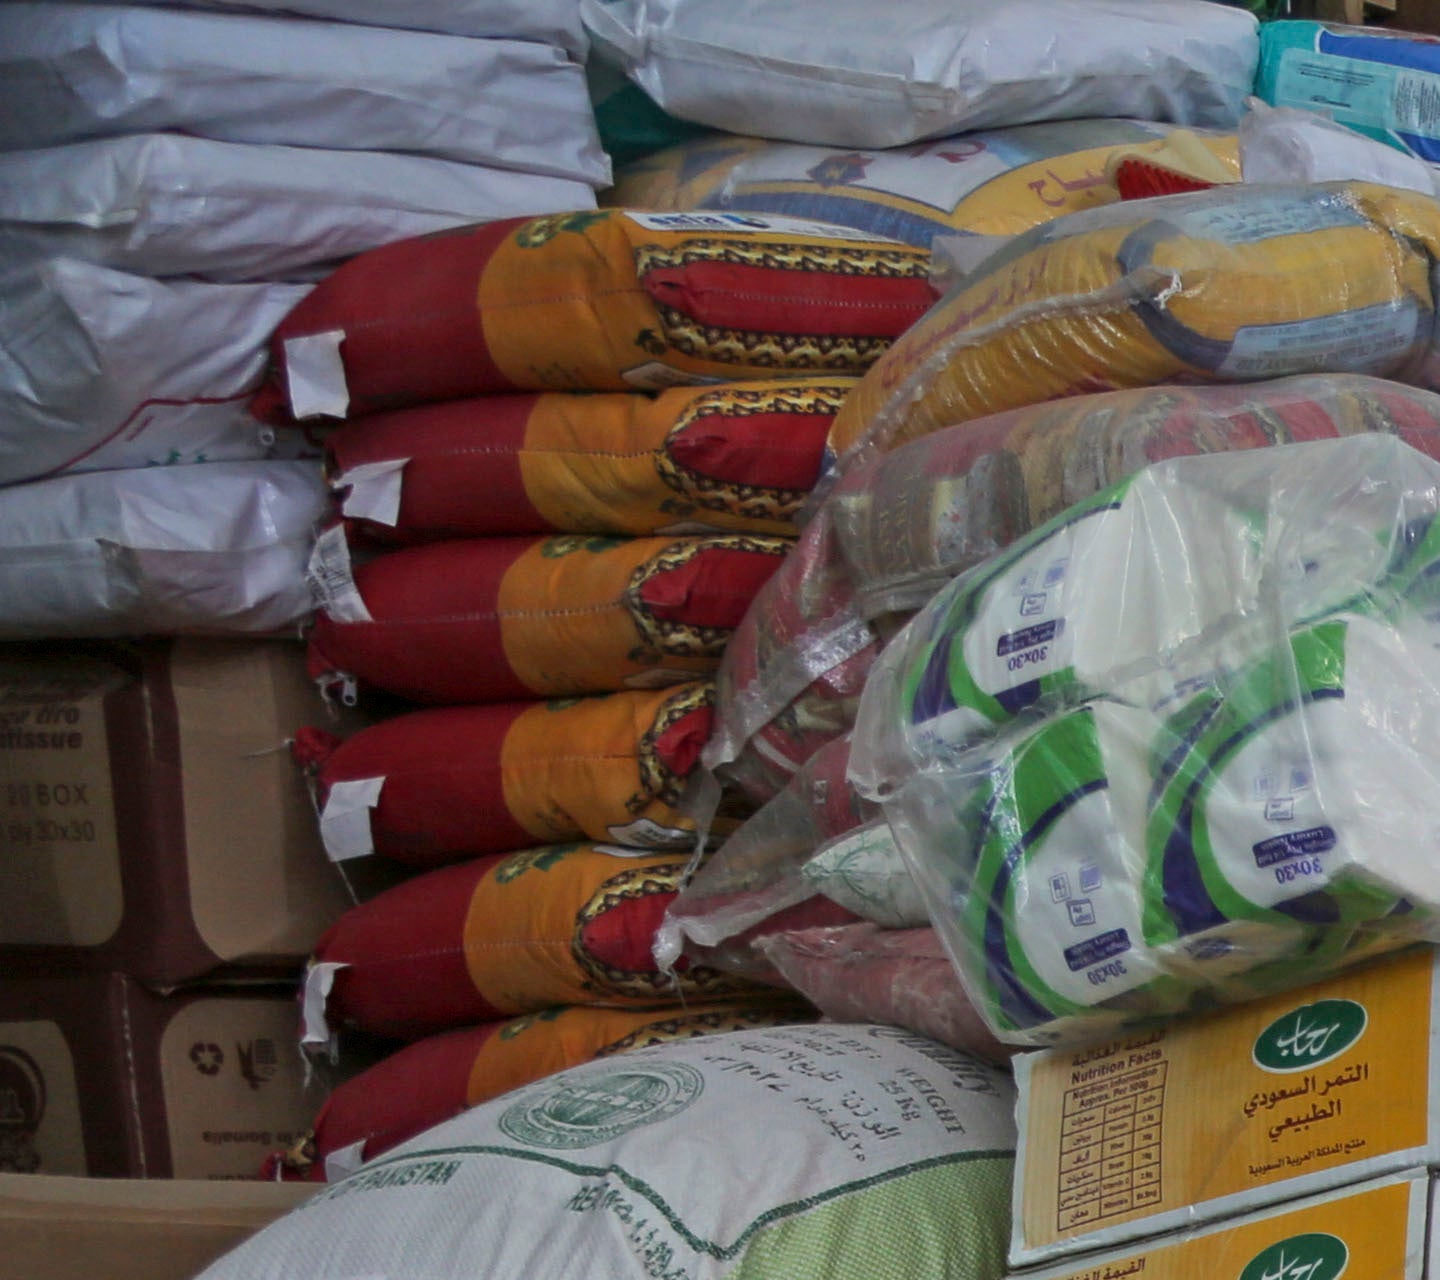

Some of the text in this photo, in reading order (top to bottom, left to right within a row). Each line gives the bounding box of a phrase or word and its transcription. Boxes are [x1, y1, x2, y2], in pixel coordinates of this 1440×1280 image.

[1274, 858, 1323, 884] 30x30
[1087, 959, 1128, 986] 30x30
[1071, 1048, 1163, 1086] Nutrition Facts
[1242, 1062, 1370, 1119] التمر السعودي
[1267, 1098, 1343, 1143] الطبيعي
